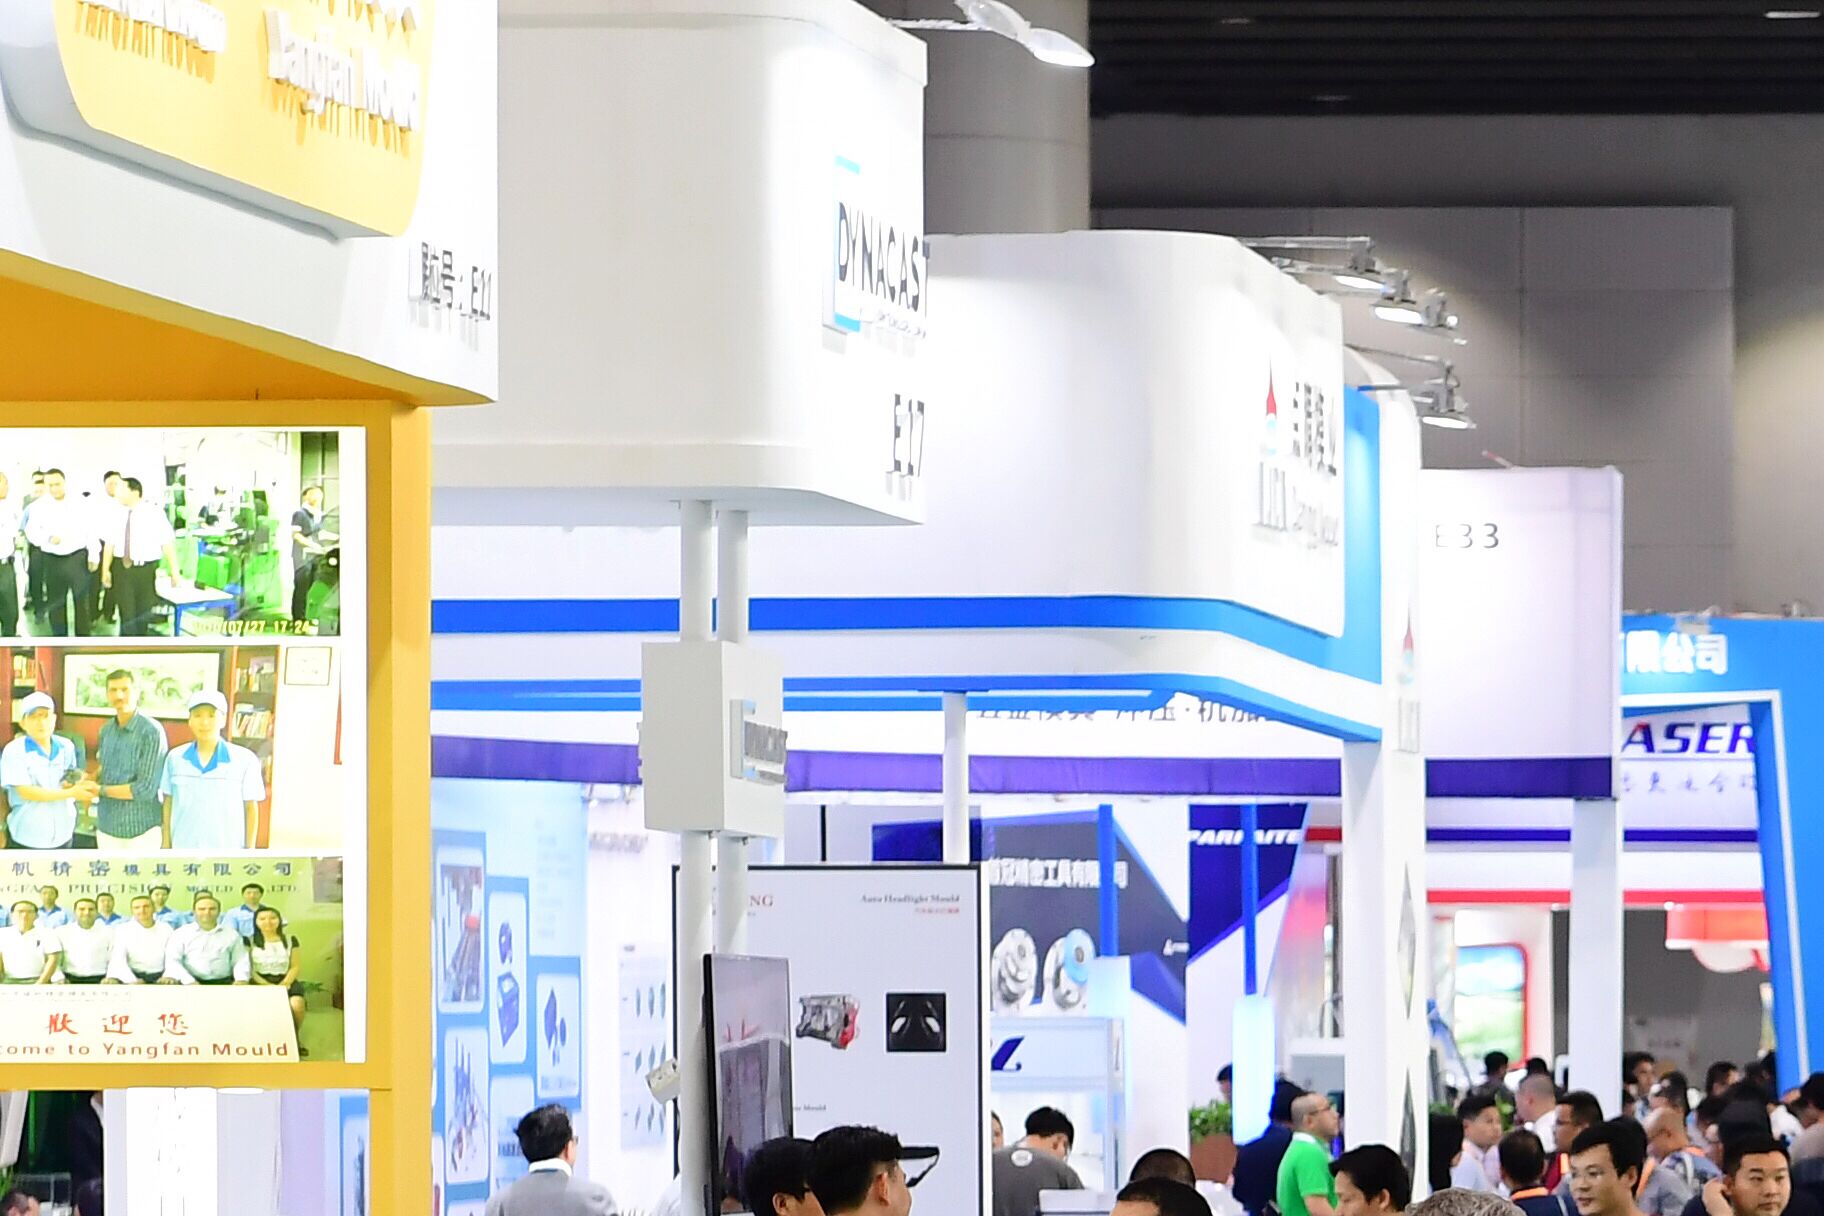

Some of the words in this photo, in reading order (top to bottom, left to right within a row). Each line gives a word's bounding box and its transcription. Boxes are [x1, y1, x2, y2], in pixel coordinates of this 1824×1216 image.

[838, 202, 931, 318] DYNACAST
[1435, 522, 1499, 549] E33
[1620, 630, 1729, 675] 限公司
[68, 1044, 90, 1056] to
[103, 1043, 199, 1060] Yangfan
[212, 1043, 289, 1057] Mould
